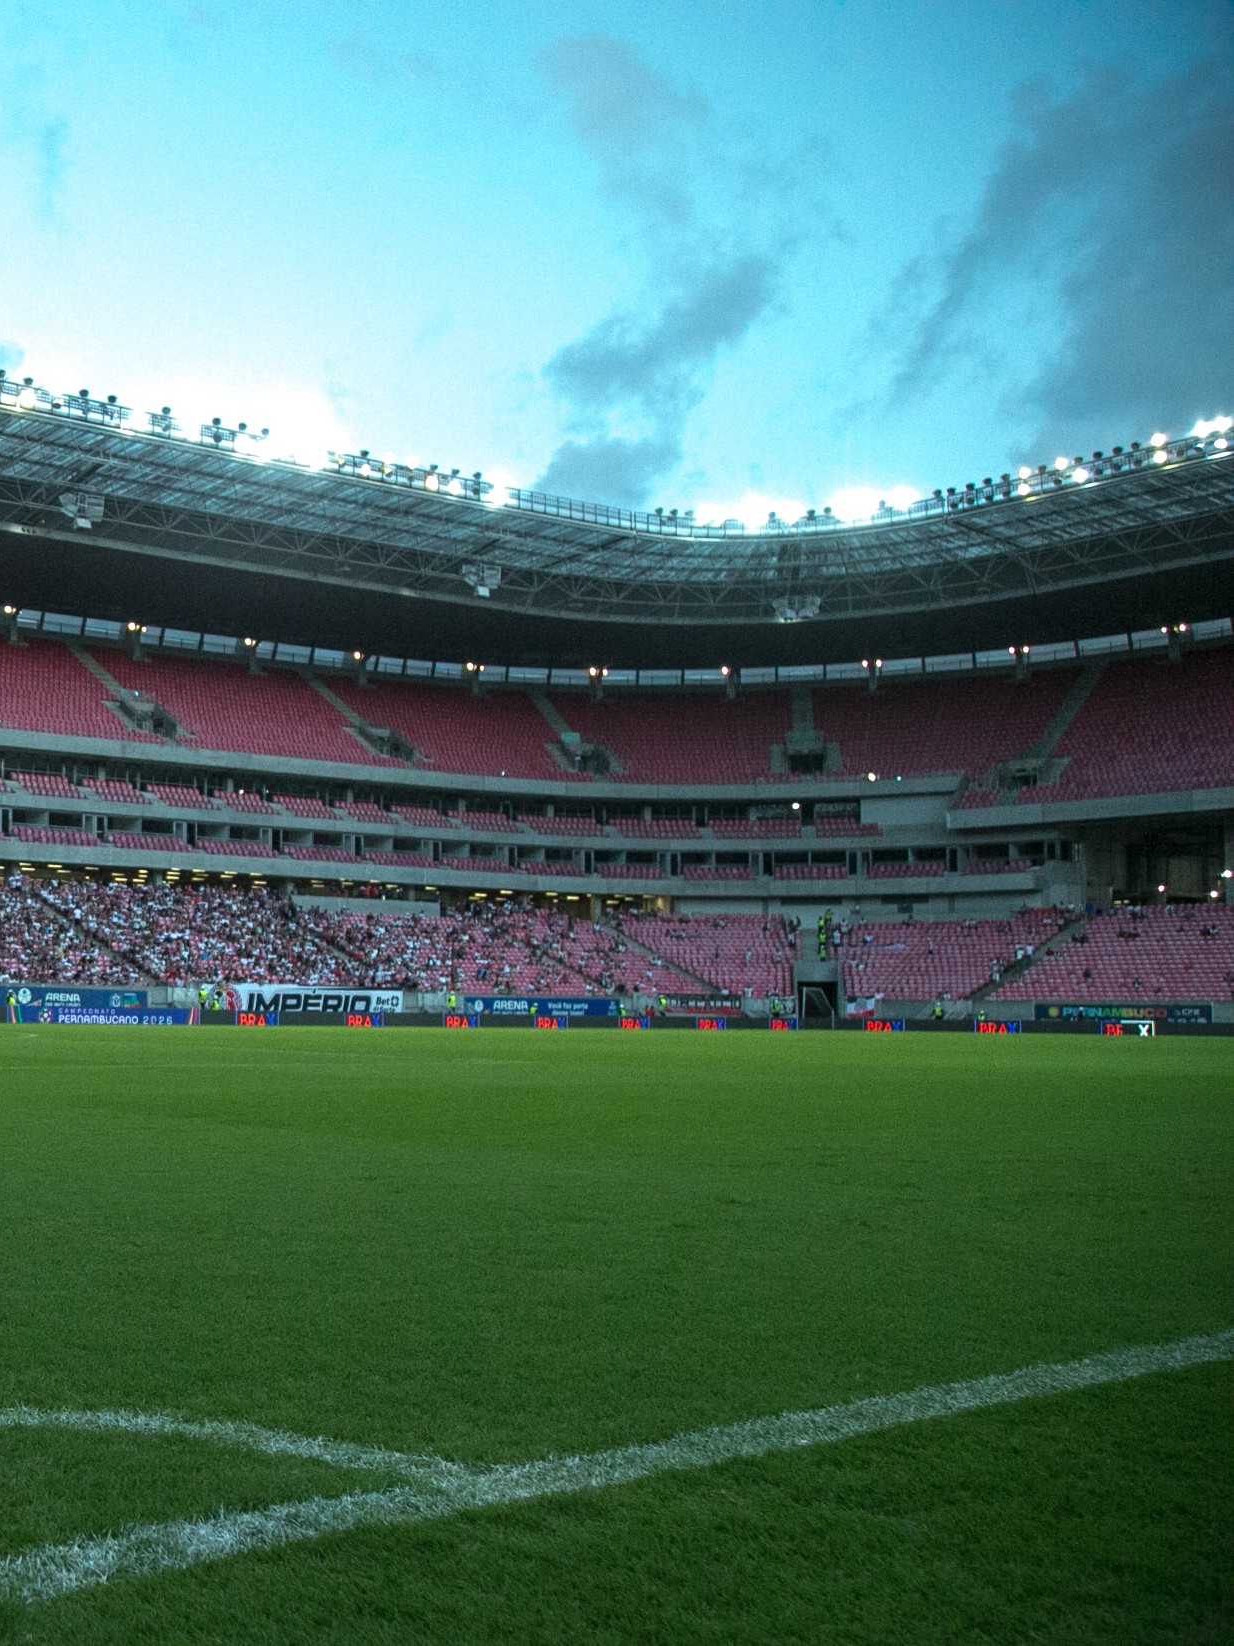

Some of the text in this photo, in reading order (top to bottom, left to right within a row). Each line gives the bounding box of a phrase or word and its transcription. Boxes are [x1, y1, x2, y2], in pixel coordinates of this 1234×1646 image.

[46, 992, 81, 1002] ARENA
[248, 988, 371, 1012] IMPÉRIO
[376, 996, 390, 1005] Bet
[493, 1000, 529, 1010] ARENA
[58, 1014, 172, 1025] PERNAMBUCANO 2026
[239, 1013, 275, 1027] BRAX
[347, 1013, 380, 1027] BRAX
[446, 1016, 475, 1028] BRAX
[537, 1017, 564, 1029] BRAX
[621, 1018, 647, 1030] BRAX
[698, 1018, 725, 1030] BRAX
[771, 1019, 793, 1031] BRAX
[866, 1020, 900, 1032] BRAX
[978, 1022, 1015, 1034] BRAX
